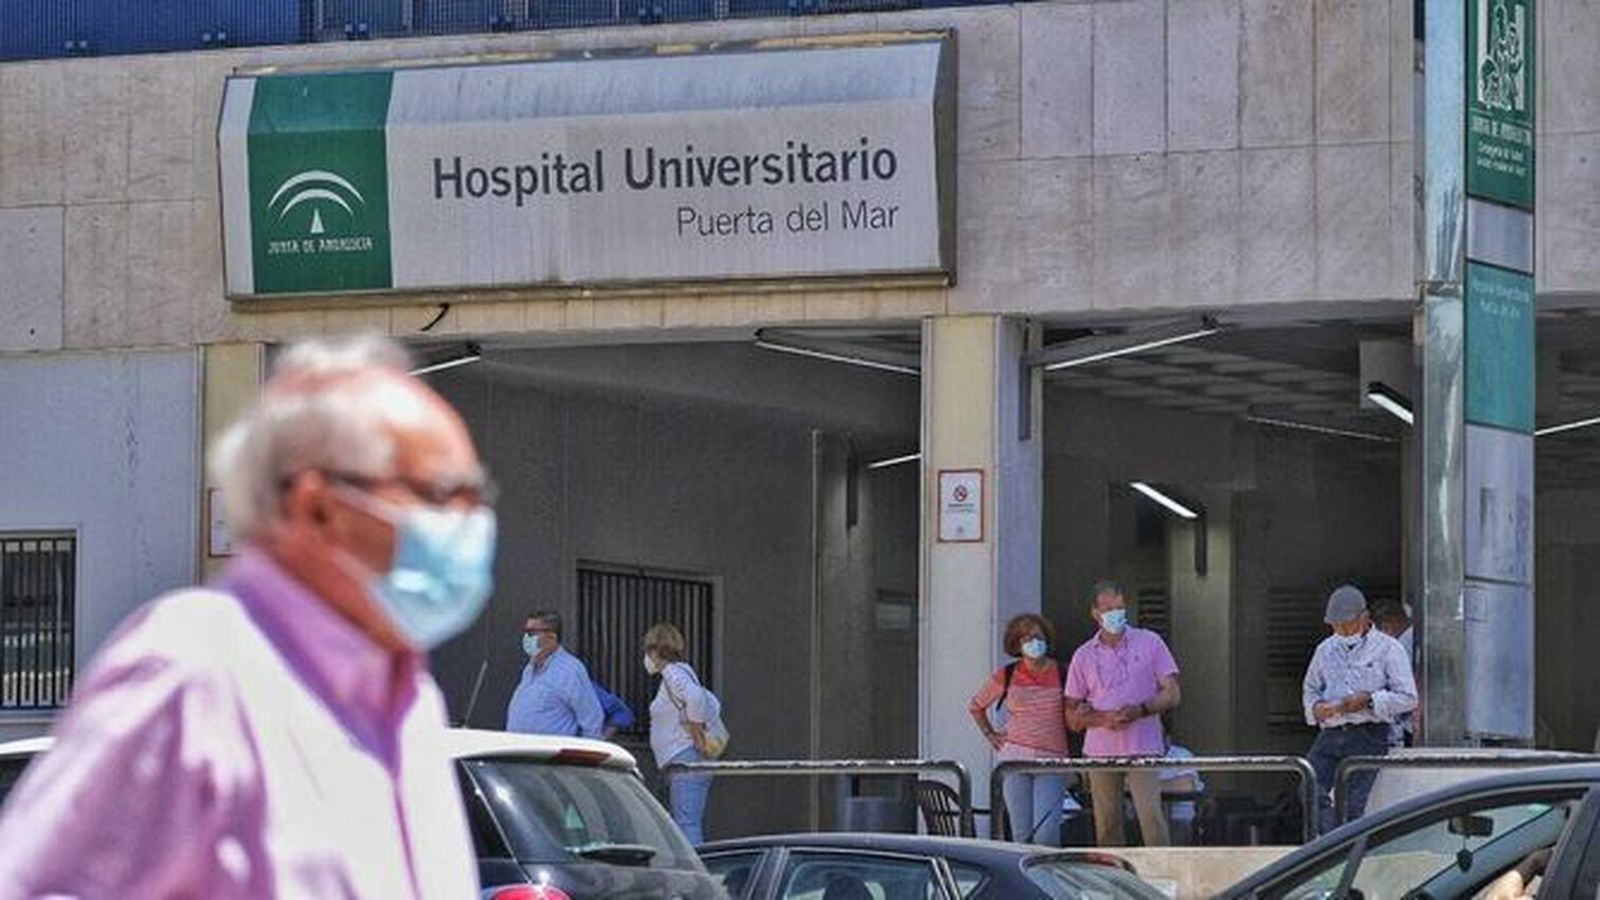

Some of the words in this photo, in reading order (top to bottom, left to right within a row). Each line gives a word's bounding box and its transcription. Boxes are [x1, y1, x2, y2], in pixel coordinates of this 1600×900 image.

[434, 149, 604, 207] Hospital
[625, 137, 898, 190] Universitario
[677, 205, 774, 237] Puerta
[786, 200, 829, 233] del
[842, 200, 899, 230] Mar
